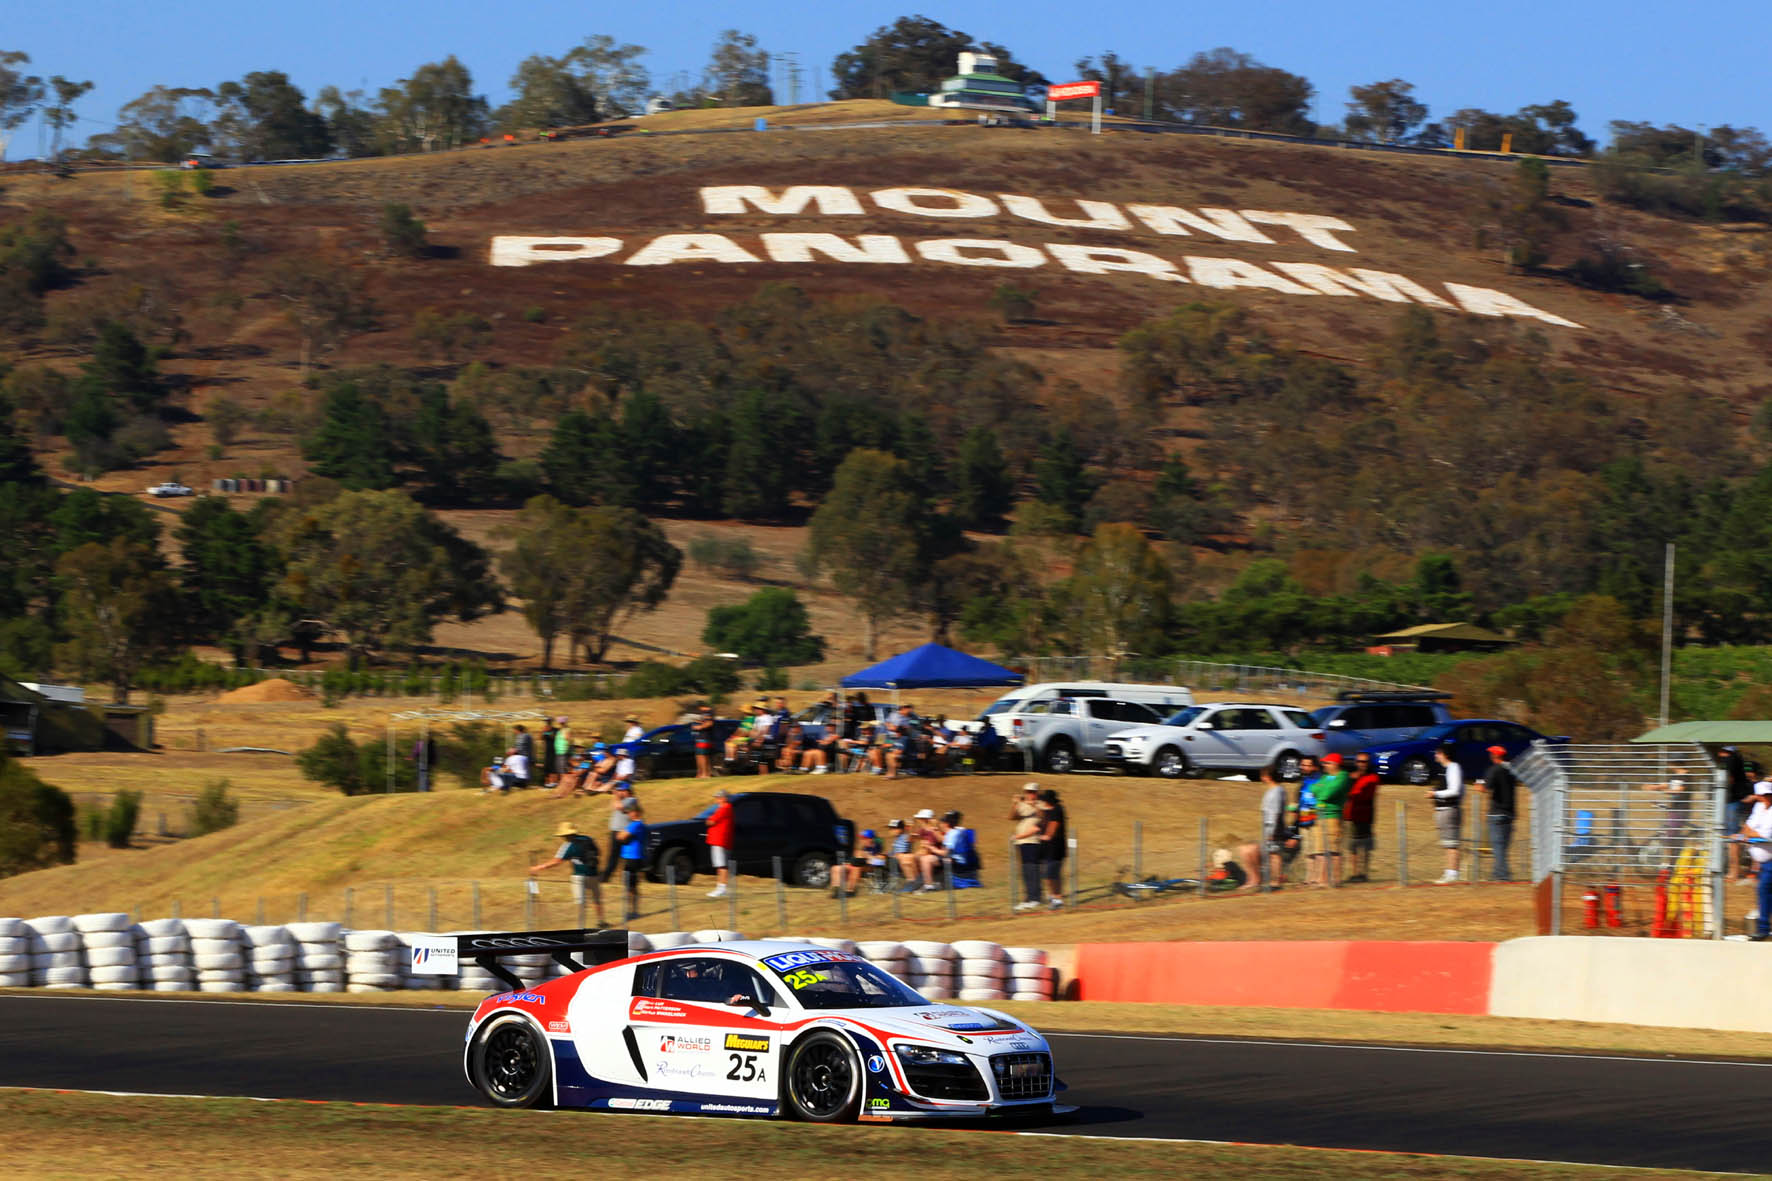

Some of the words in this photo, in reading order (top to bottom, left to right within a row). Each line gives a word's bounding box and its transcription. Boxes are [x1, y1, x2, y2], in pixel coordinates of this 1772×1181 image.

[701, 185, 1357, 252] MOUNT
[490, 232, 1585, 329] PANORAMA
[768, 952, 827, 969] LIQUI
[677, 1036, 711, 1045] ALLIED
[677, 1043, 711, 1051] WORLD
[634, 1099, 673, 1110] EDGE
